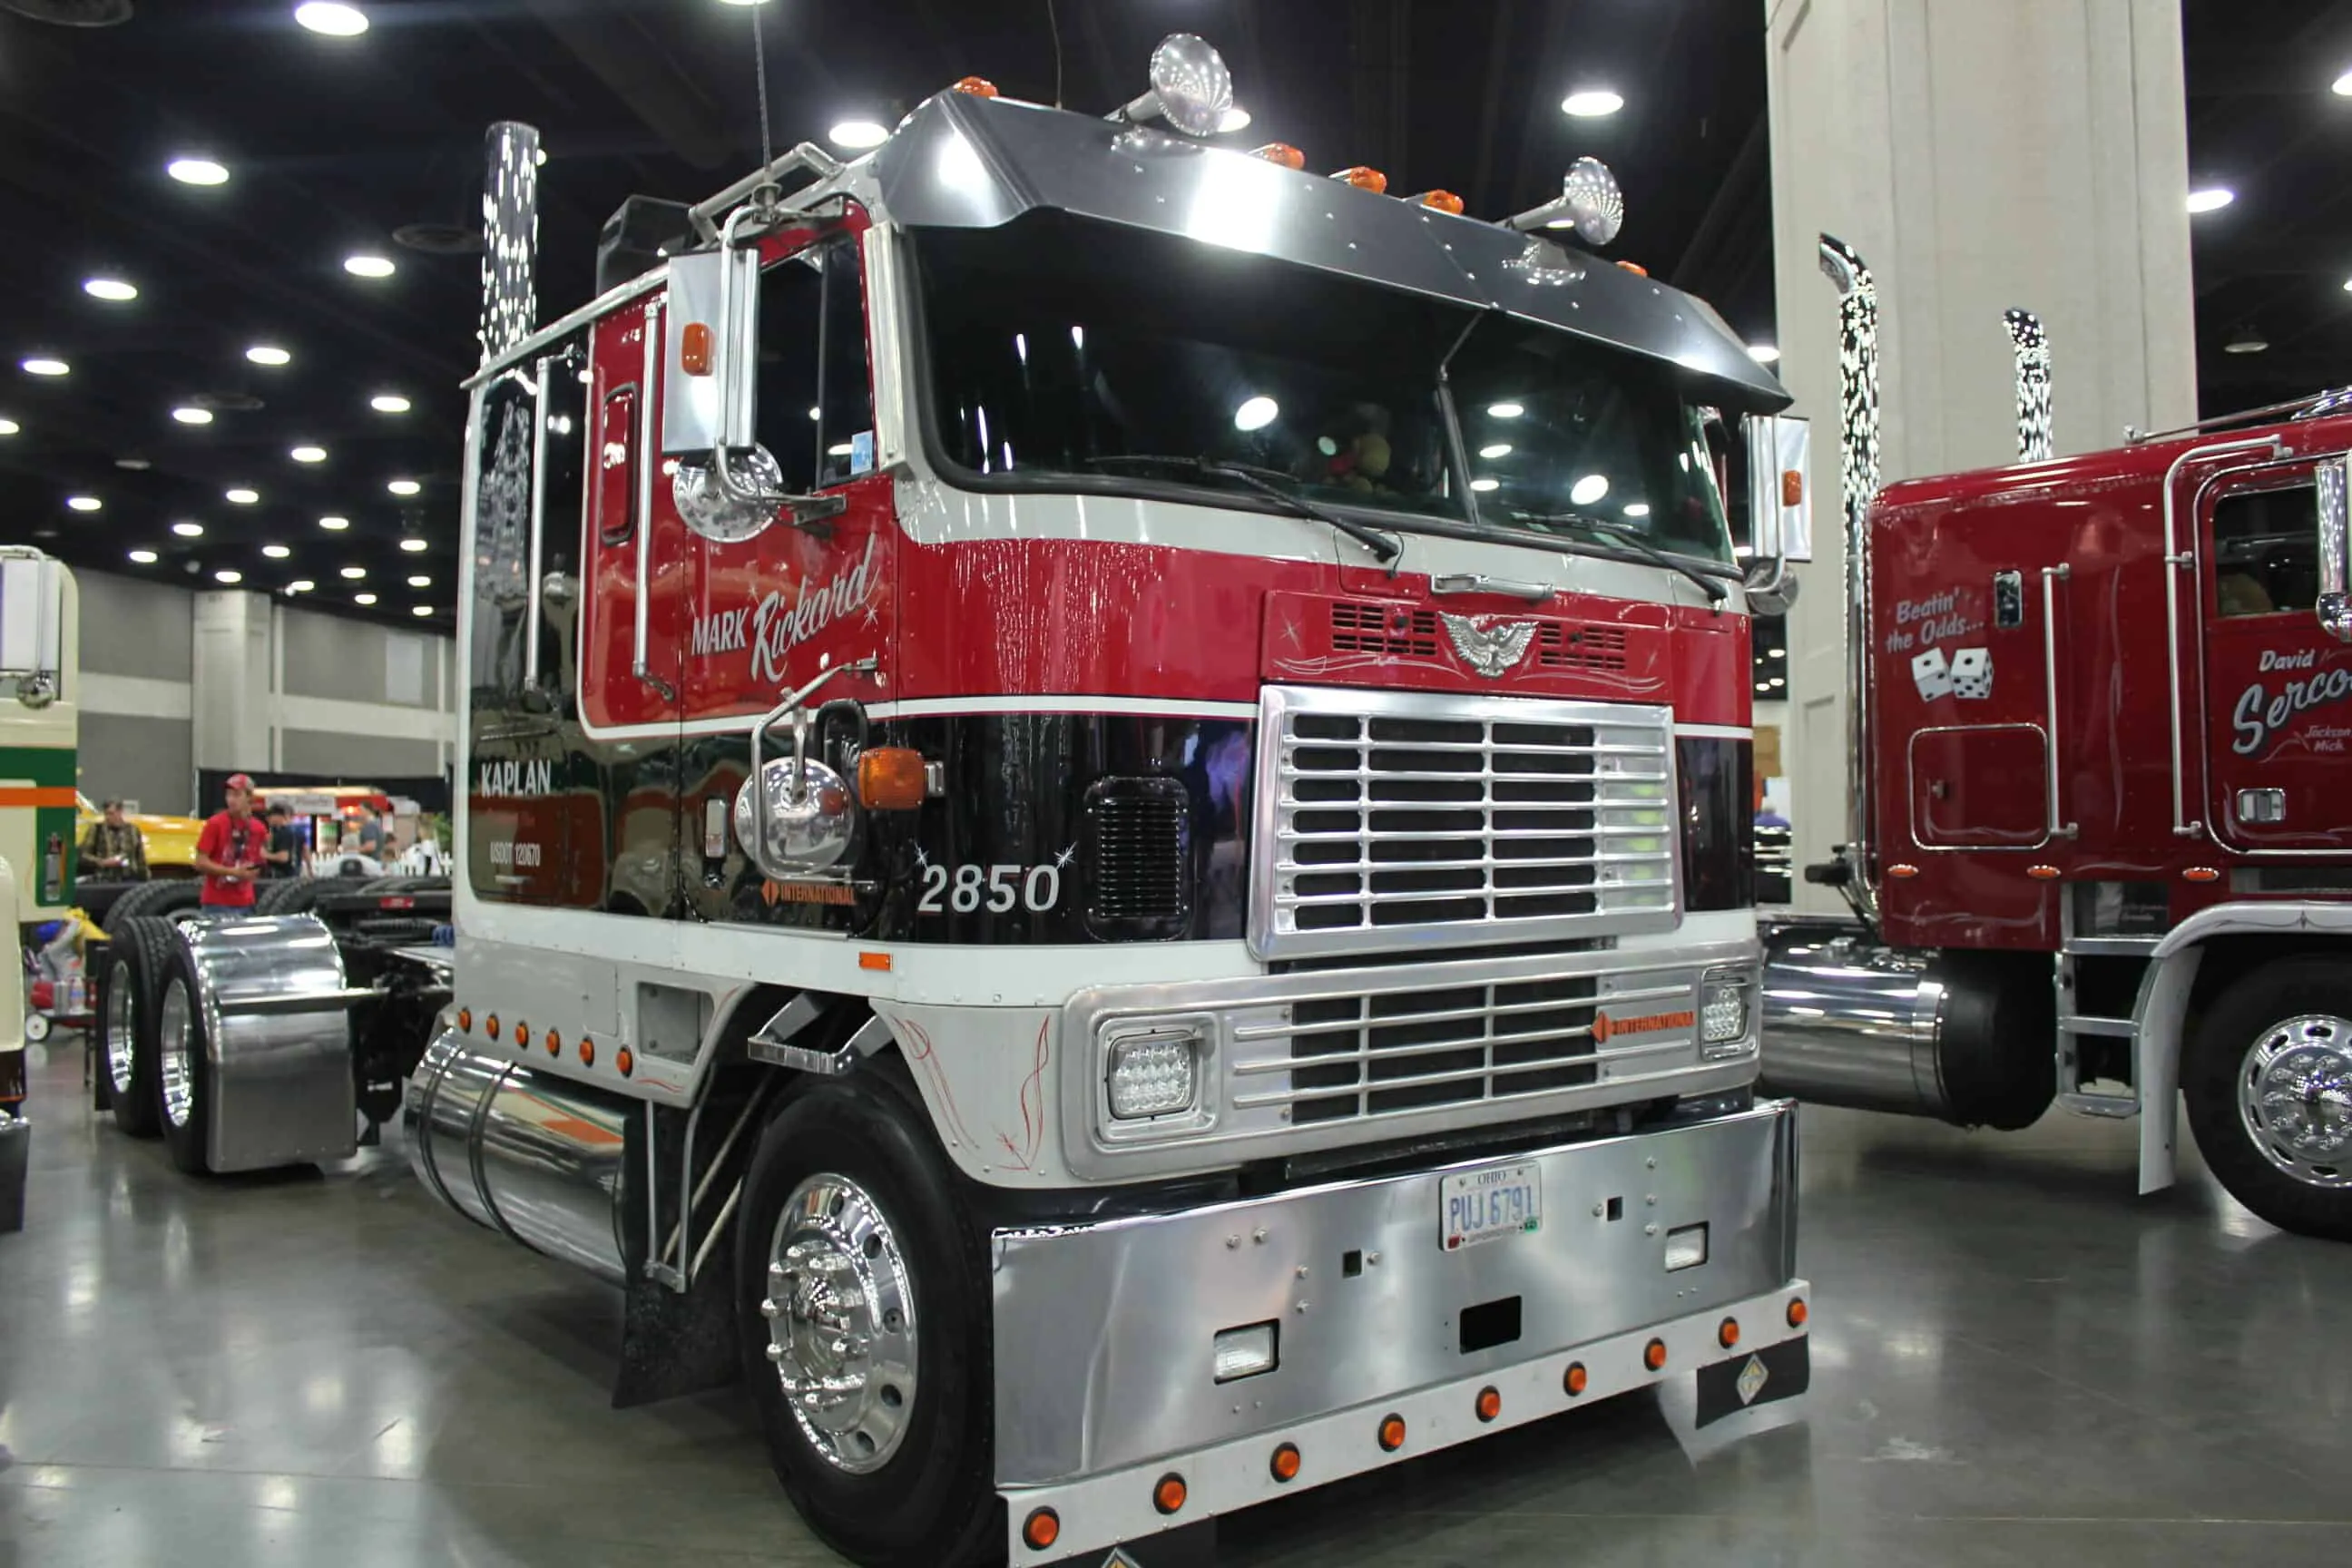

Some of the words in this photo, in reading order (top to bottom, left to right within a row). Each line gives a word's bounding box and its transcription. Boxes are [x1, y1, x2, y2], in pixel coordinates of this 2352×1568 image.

[691, 606, 750, 655] MARK
[751, 532, 880, 681] Rickard
[1896, 586, 1960, 624] Beatin'
[1886, 628, 1914, 653] the
[1921, 612, 1984, 644] Odds...
[2258, 648, 2316, 671] David
[481, 759, 551, 799] KAPLAN
[490, 841, 514, 865] USDOT
[780, 883, 858, 906] INTERNATIONAL
[917, 864, 1060, 913] 2850
[1477, 1170, 1507, 1185] OHIO
[1450, 1191, 1485, 1233] PUJ
[1489, 1184, 1532, 1226] 6791
